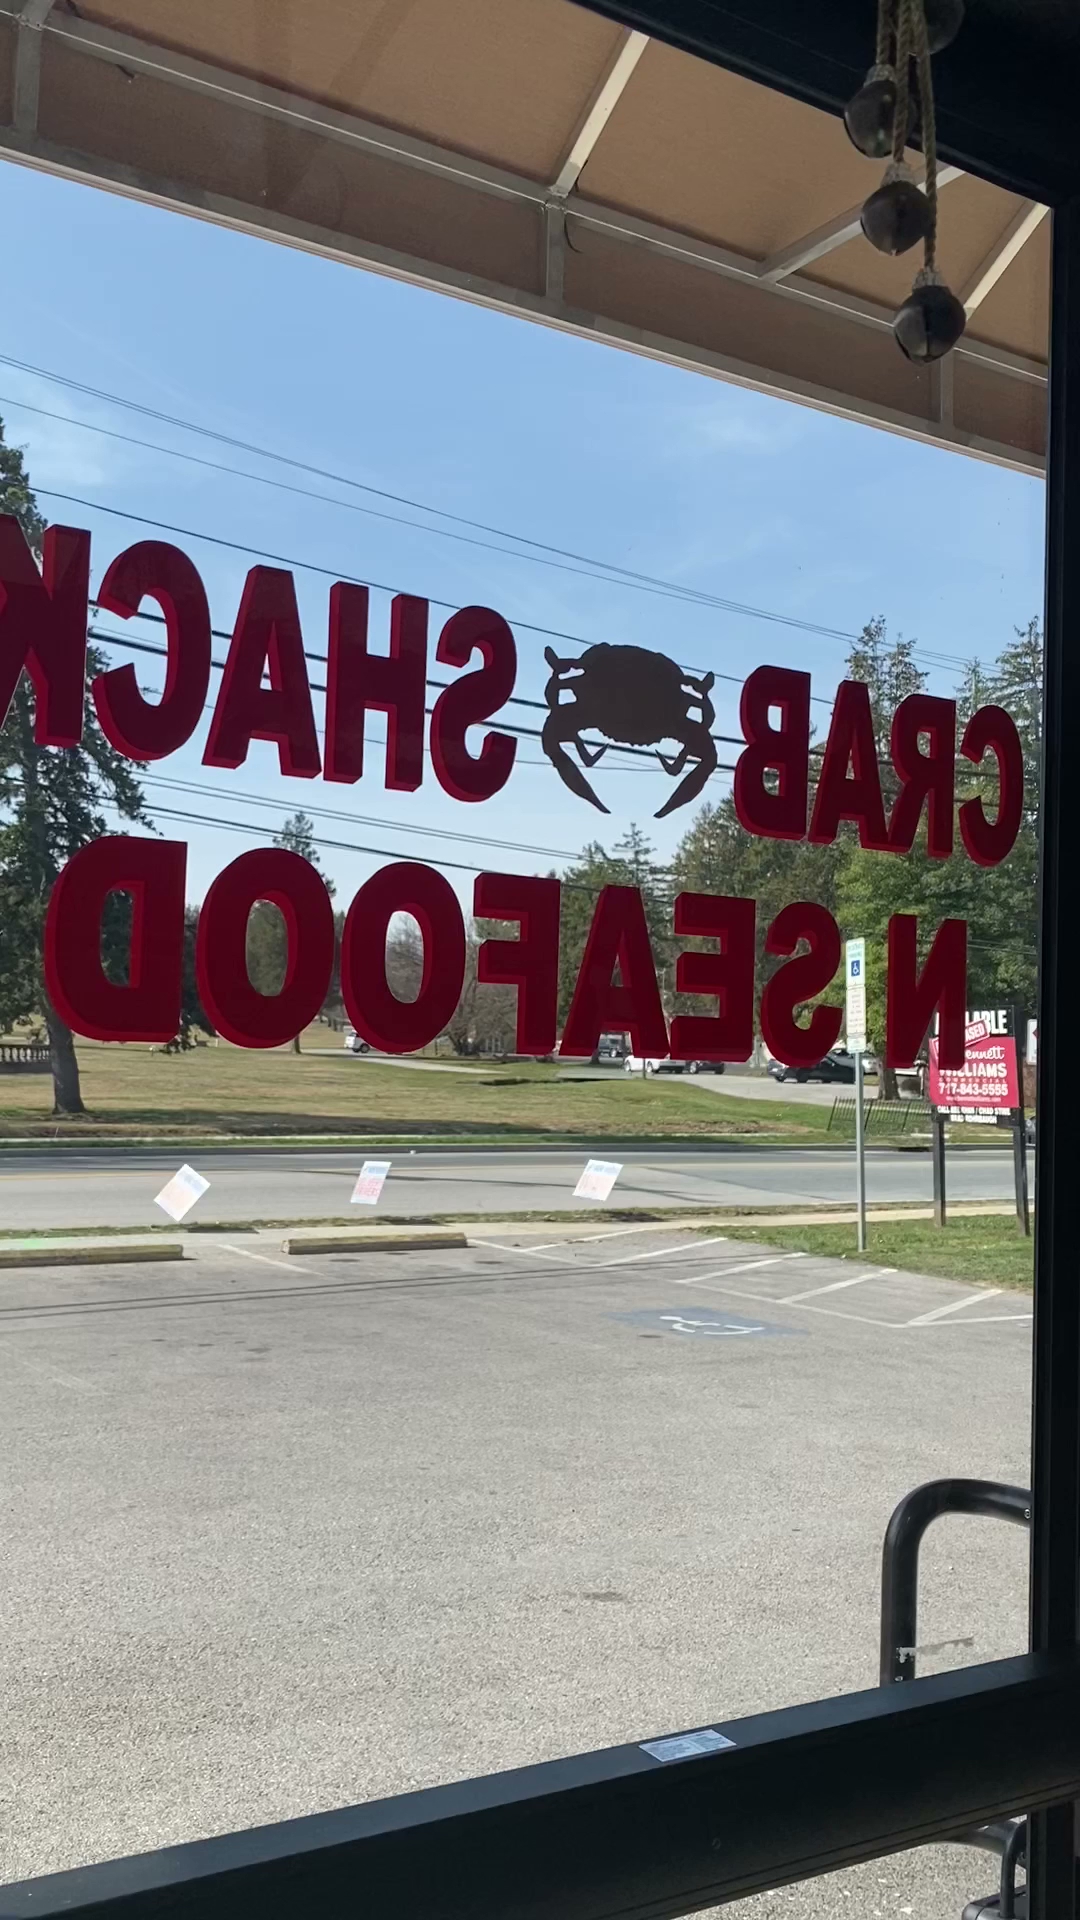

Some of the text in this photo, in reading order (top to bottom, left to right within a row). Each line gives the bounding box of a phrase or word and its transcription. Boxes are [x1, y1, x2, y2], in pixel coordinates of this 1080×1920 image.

[935, 1009, 1008, 1035] LABLE
[965, 1045, 1005, 1060] ennett
[938, 1083, 1009, 1097] 717-843-5555
